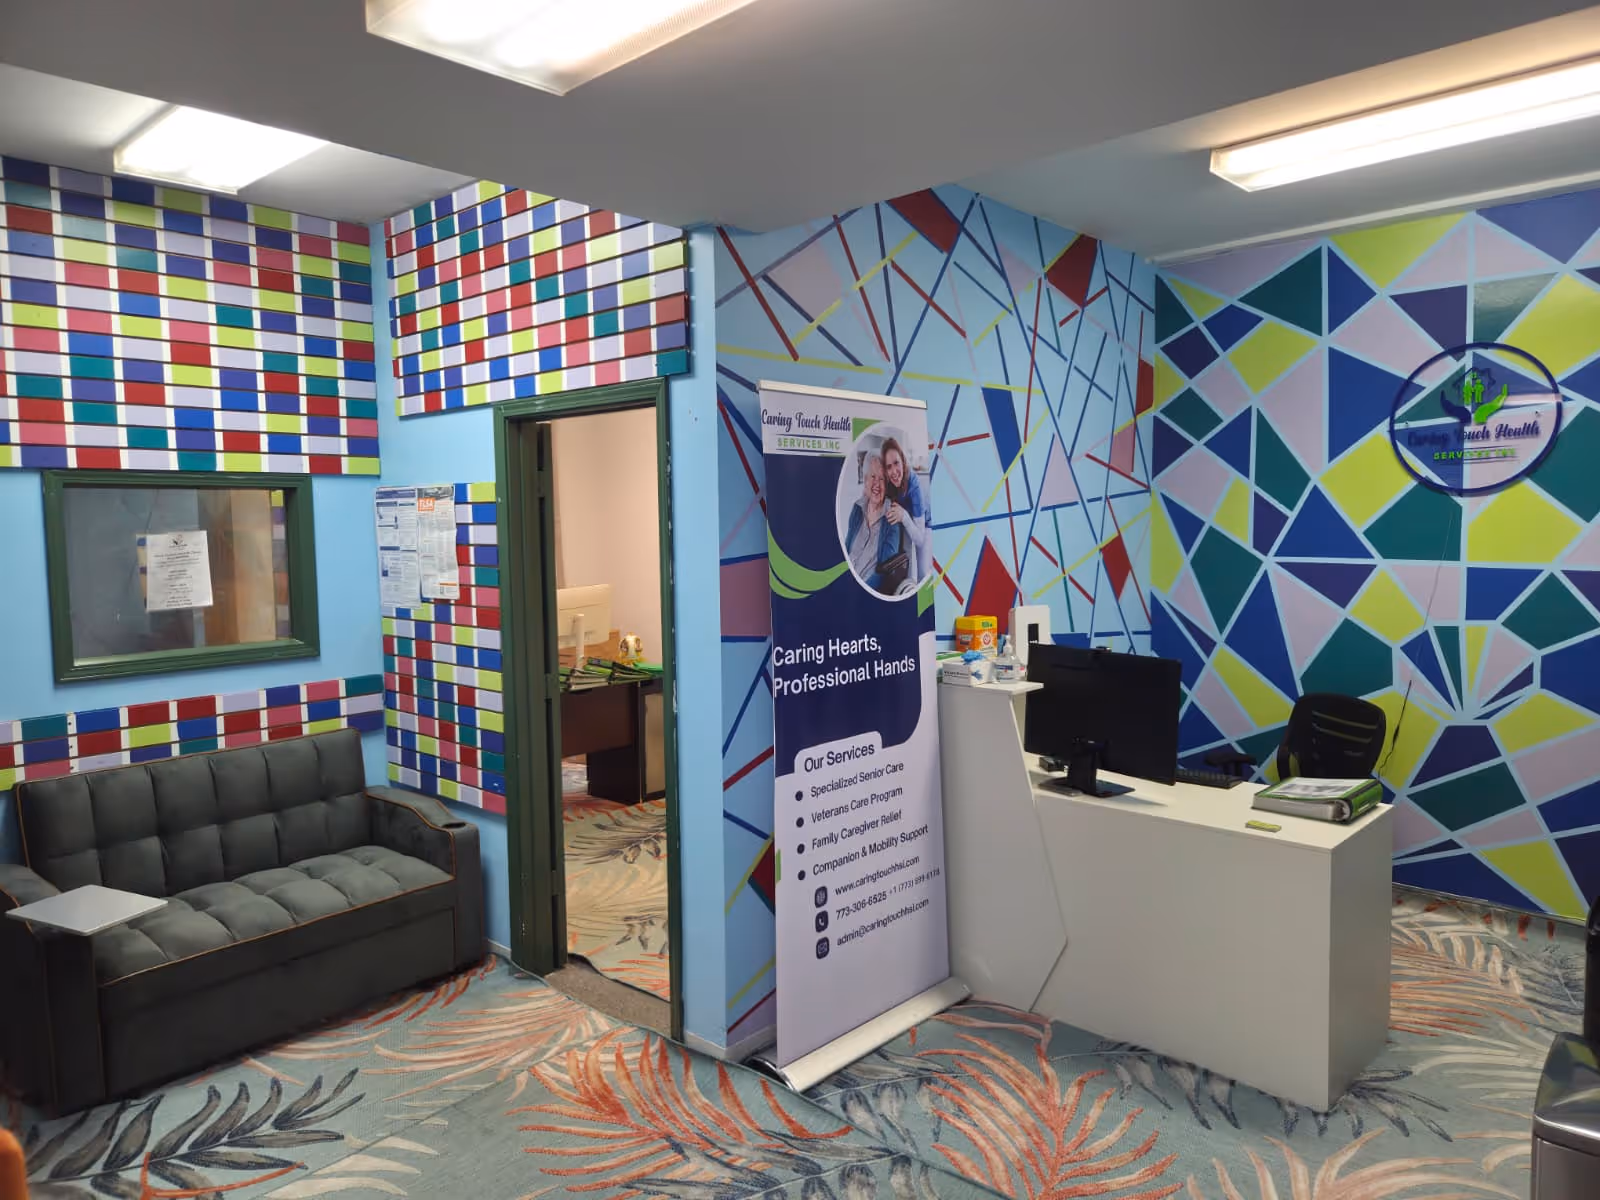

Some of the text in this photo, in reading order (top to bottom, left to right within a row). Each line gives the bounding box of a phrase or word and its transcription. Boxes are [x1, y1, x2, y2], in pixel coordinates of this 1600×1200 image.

[761, 408, 851, 432] Caring Touch Health
[1495, 420, 1540, 439] Health
[777, 438, 822, 449] SERVICES
[772, 634, 882, 667] Caring Hearts,
[773, 655, 916, 698] Professional Hands
[804, 744, 875, 773] Our Services
[810, 761, 904, 798] Specialized Senior Care
[811, 787, 903, 824] Veterans Care Program
[812, 809, 902, 850] Family Caregiver Relief
[813, 824, 928, 876] Companion & Mobility Support
[835, 856, 920, 895] www.caringtouchhsi.com
[836, 891, 887, 920] 773-306-6525
[837, 898, 930, 946] admin@caringtouchhsi.com
